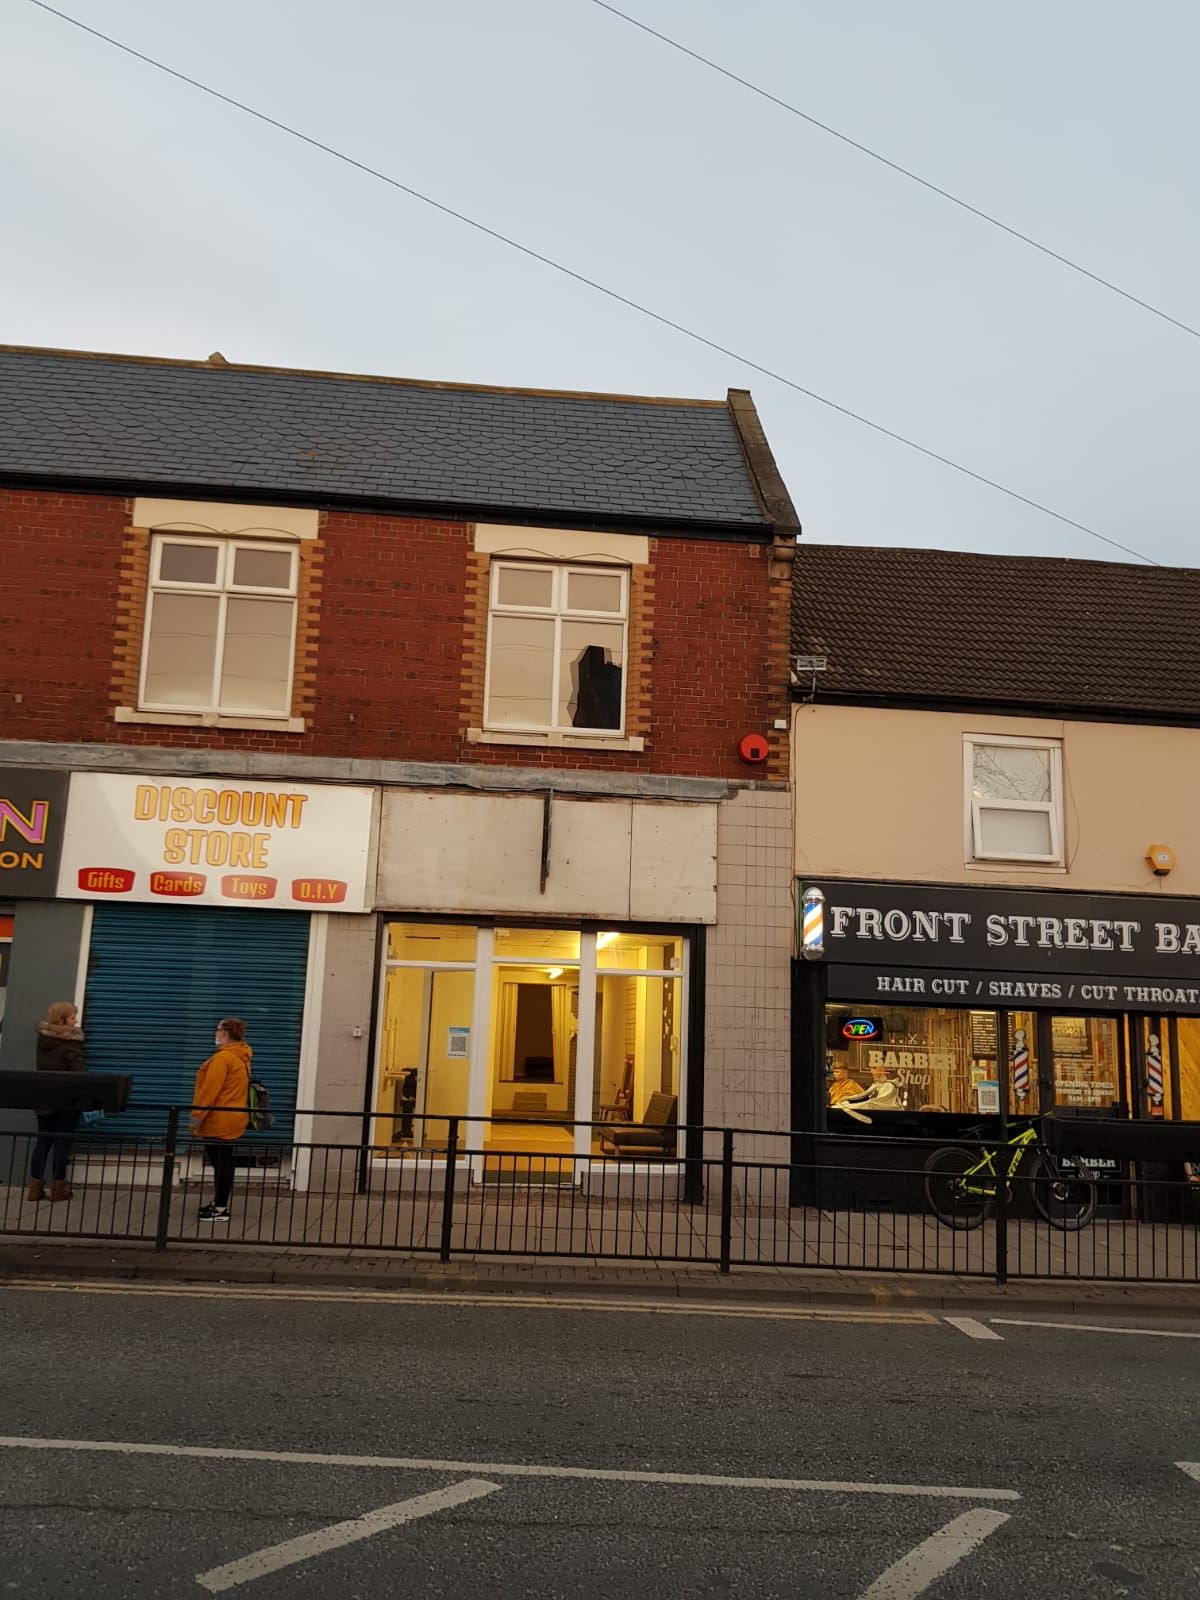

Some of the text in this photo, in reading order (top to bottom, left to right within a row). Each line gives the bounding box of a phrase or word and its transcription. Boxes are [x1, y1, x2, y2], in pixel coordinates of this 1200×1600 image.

[134, 784, 309, 829] DISCOUNT
[163, 828, 272, 869] STORE
[87, 871, 125, 890] Gifts
[153, 875, 202, 893] Cards
[231, 877, 268, 898] Toys
[301, 882, 338, 900] D.I.Y
[830, 906, 1200, 955] FRONT STREET BA
[876, 976, 1199, 1004] HAIR CUT / SHAVES / CUT THROAT
[842, 1022, 875, 1036] OPEN
[868, 1050, 957, 1070] BARBER
[896, 1068, 931, 1089] Shop
